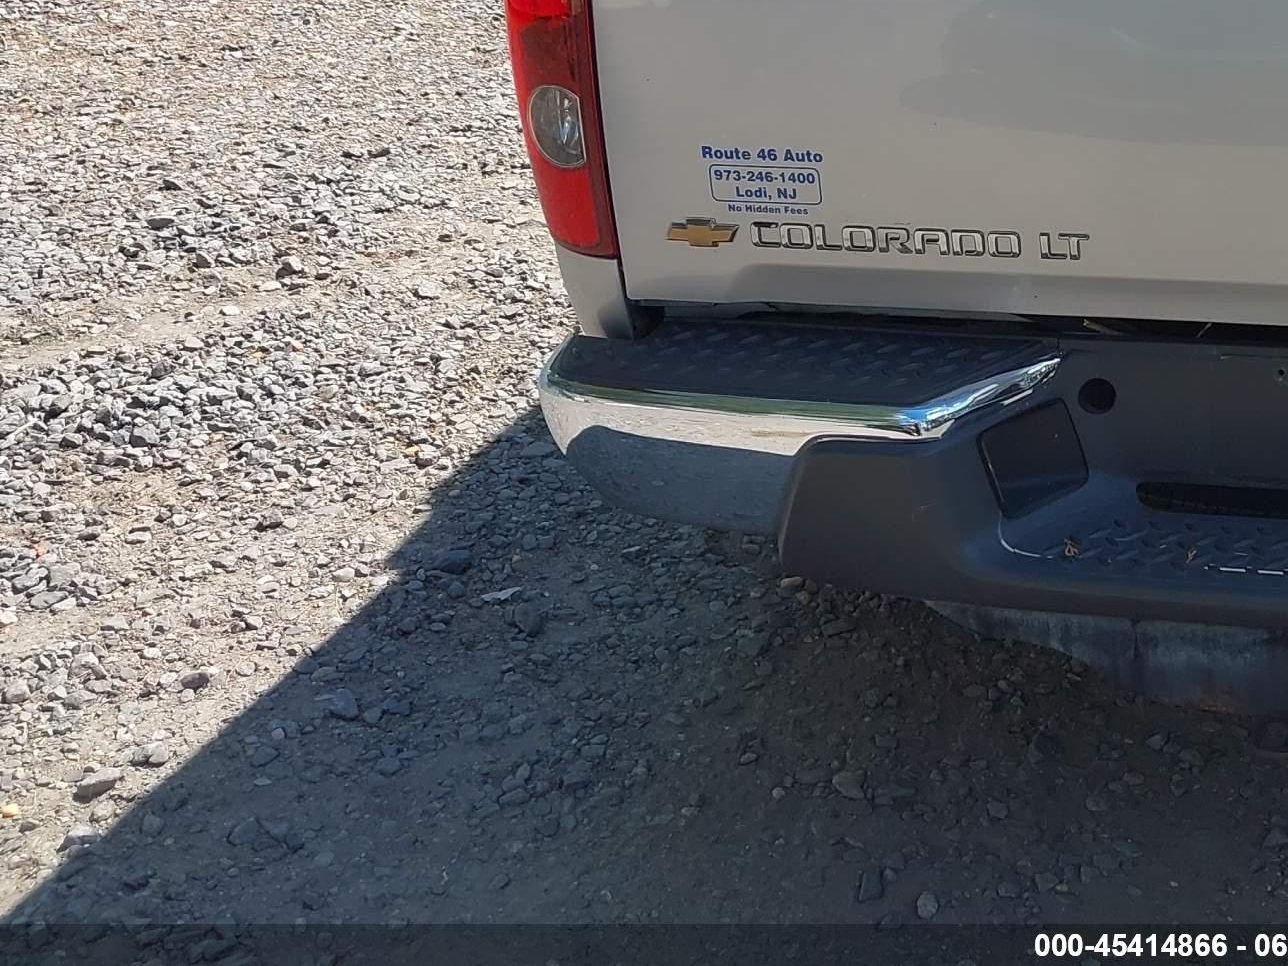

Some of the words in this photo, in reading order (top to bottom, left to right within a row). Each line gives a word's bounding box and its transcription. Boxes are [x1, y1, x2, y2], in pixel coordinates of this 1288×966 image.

[701, 145, 751, 160] Route
[757, 148, 778, 161] 46
[783, 149, 823, 163] Auto
[713, 169, 815, 184] 973-246-1400
[735, 186, 772, 201] Lodi,
[777, 188, 797, 199] NJ
[728, 204, 742, 212] No
[745, 205, 781, 214] Hidden
[784, 206, 809, 215] Fees
[749, 221, 1022, 259] COLORADO
[1039, 231, 1090, 261] LT
